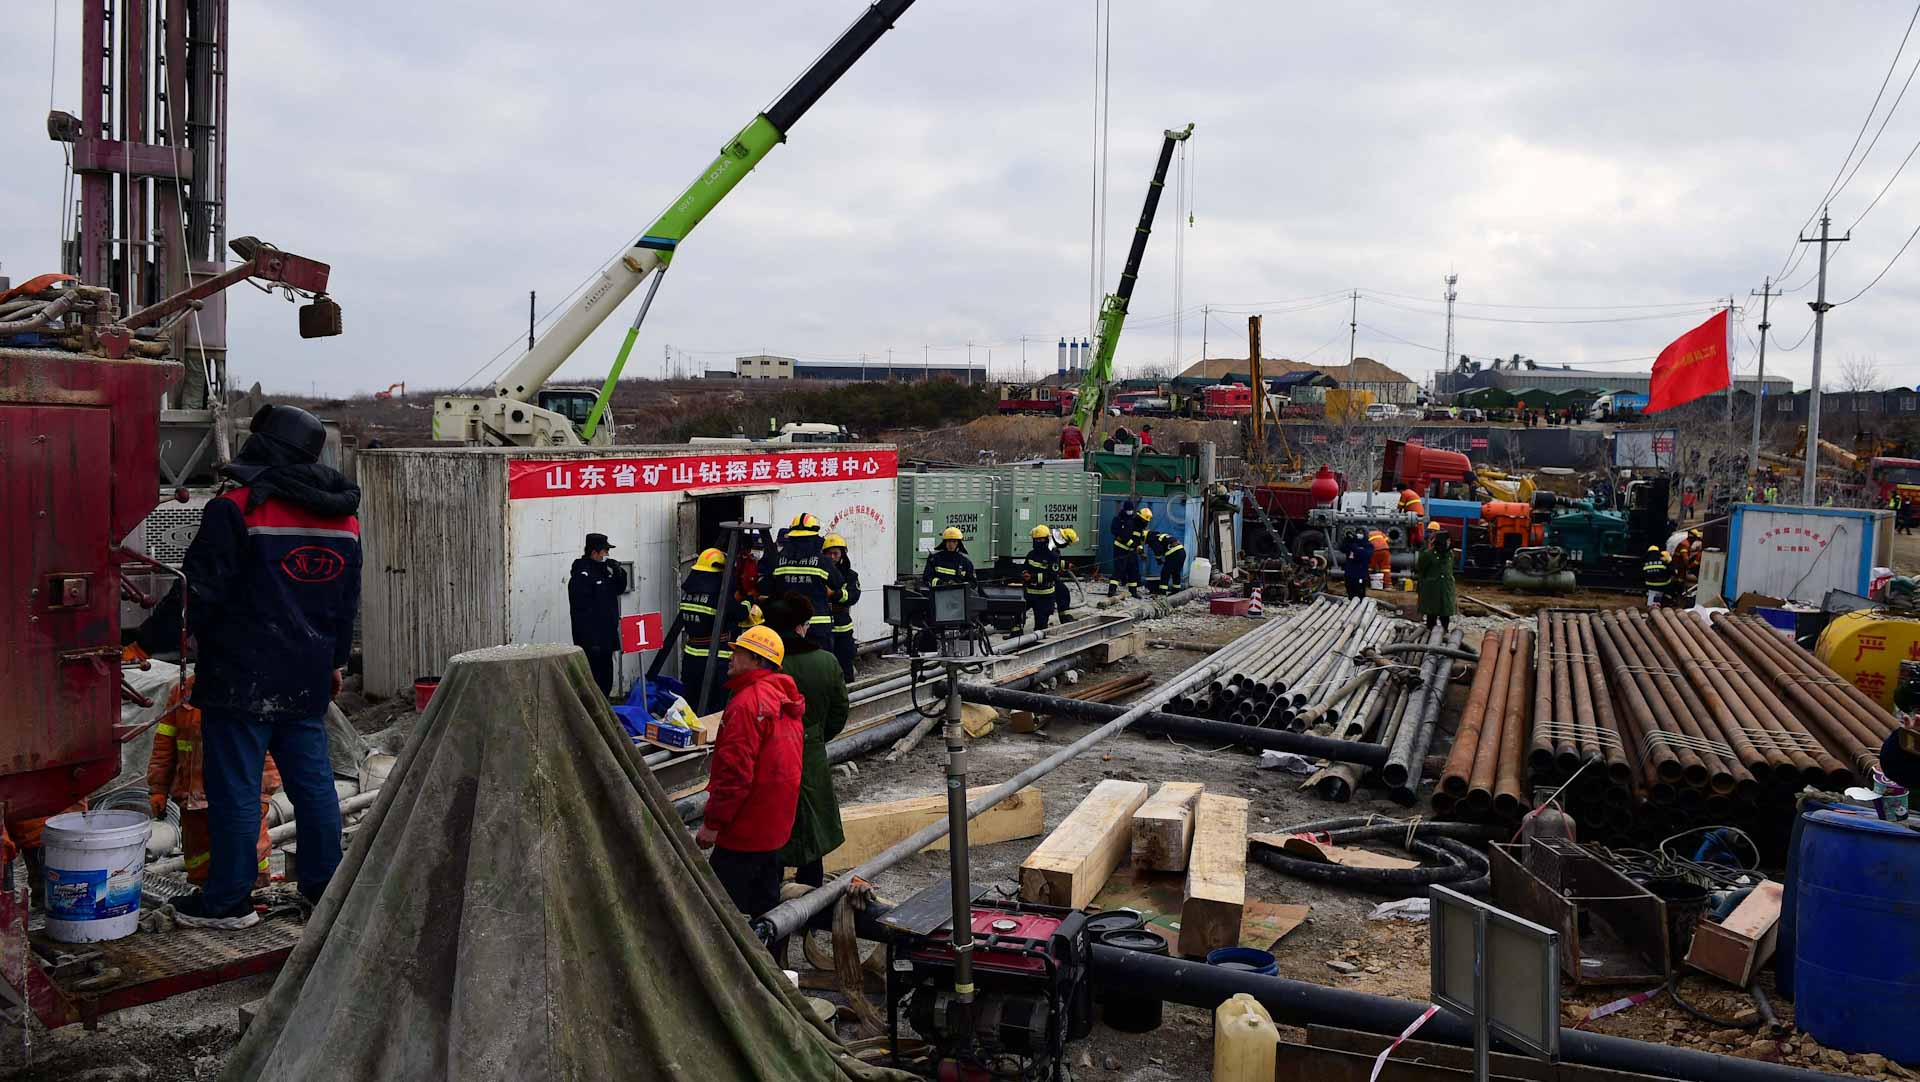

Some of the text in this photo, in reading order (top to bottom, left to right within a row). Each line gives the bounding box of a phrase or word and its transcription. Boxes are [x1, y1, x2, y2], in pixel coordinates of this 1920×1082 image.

[546, 456, 880, 490] 山东省矿山钻探应急救援中心
[1044, 504, 1078, 512] 1250XHH
[946, 514, 978, 523] 1250XHH
[635, 620, 649, 646] 1
